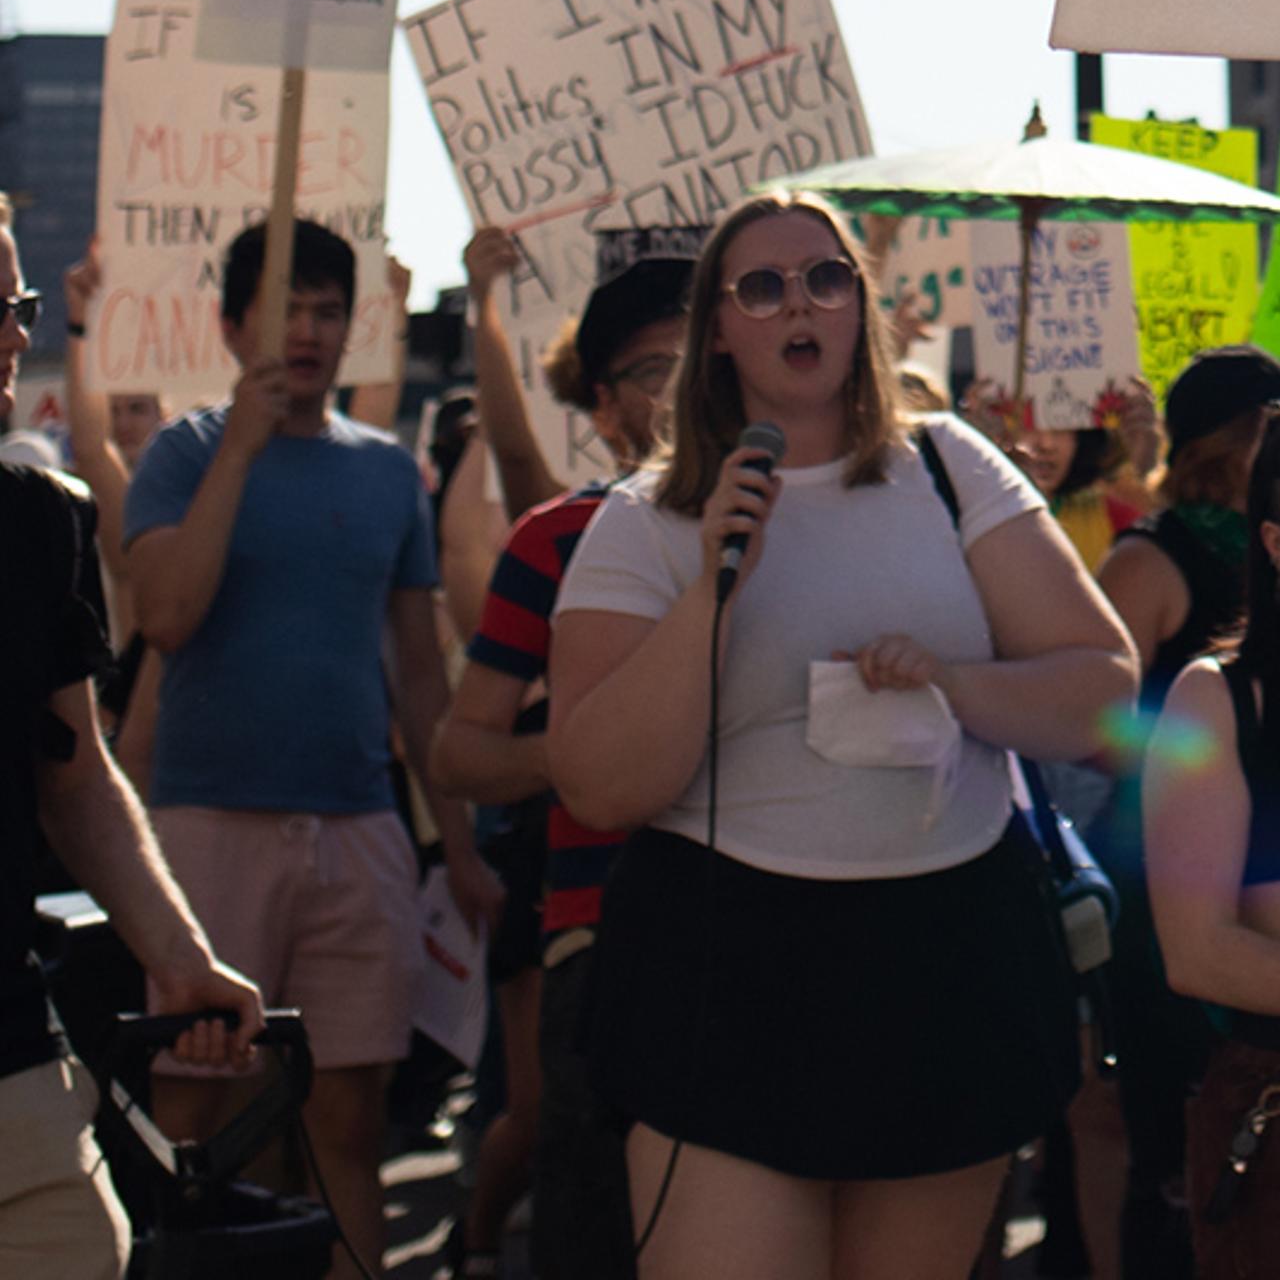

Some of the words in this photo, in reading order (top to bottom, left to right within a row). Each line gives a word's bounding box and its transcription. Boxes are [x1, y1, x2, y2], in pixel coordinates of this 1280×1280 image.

[127, 7, 192, 61] IF
[404, 0, 487, 86] IF
[606, 12, 702, 95] IN
[221, 83, 259, 122] IS
[734, 33, 850, 131] FUCK
[126, 124, 376, 197] MURER
[114, 201, 220, 245] THEN
